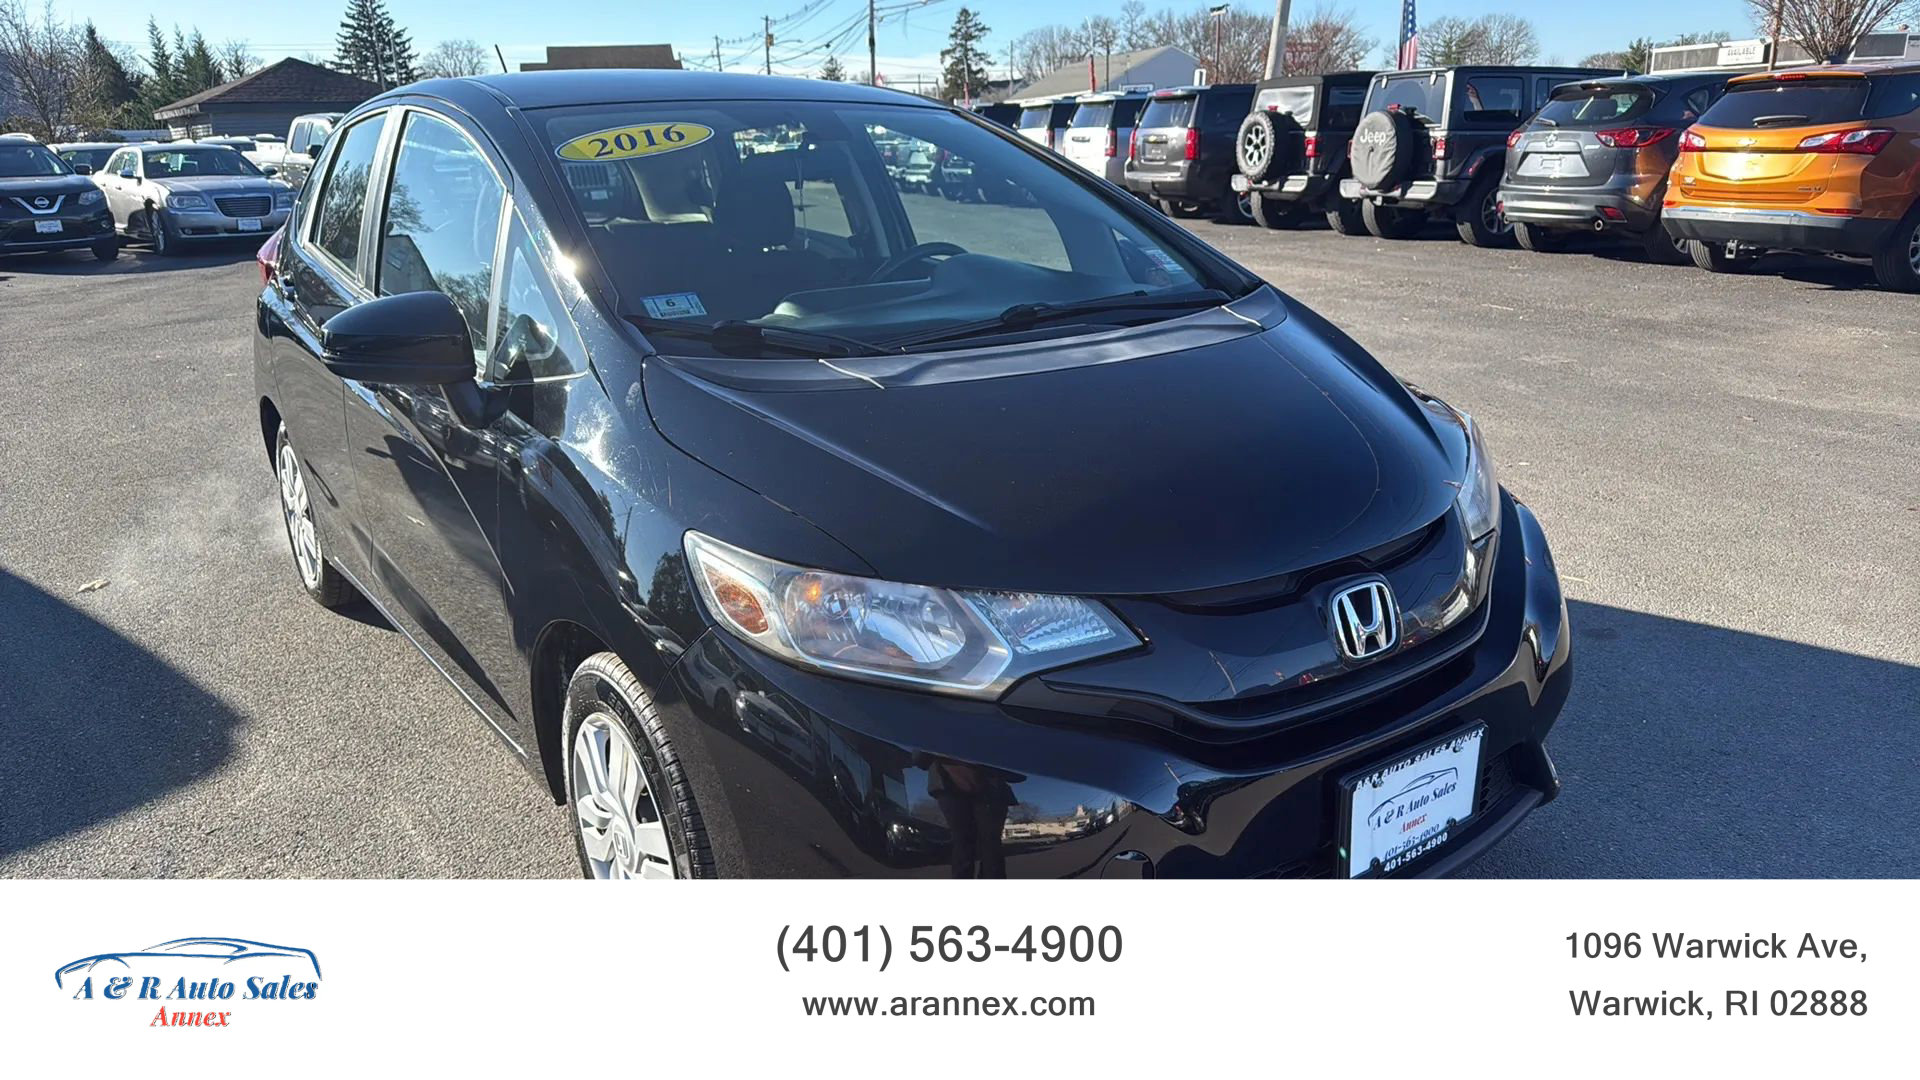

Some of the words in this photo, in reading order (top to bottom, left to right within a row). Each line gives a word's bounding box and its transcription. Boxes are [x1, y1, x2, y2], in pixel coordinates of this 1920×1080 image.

[588, 124, 686, 158] 2016
[1360, 128, 1386, 146] Jeep
[665, 298, 676, 307] 6
[1381, 758, 1412, 779] AUTO
[1414, 744, 1448, 766] SALES
[1449, 727, 1485, 751] ANNEX
[1373, 815, 1382, 831] A
[1384, 808, 1395, 824] &
[1396, 804, 1405, 818] R
[1406, 795, 1430, 814] Auto
[1431, 782, 1457, 801] Sales
[1399, 813, 1427, 834] Annex
[1384, 832, 1448, 872] 401-563-4900
